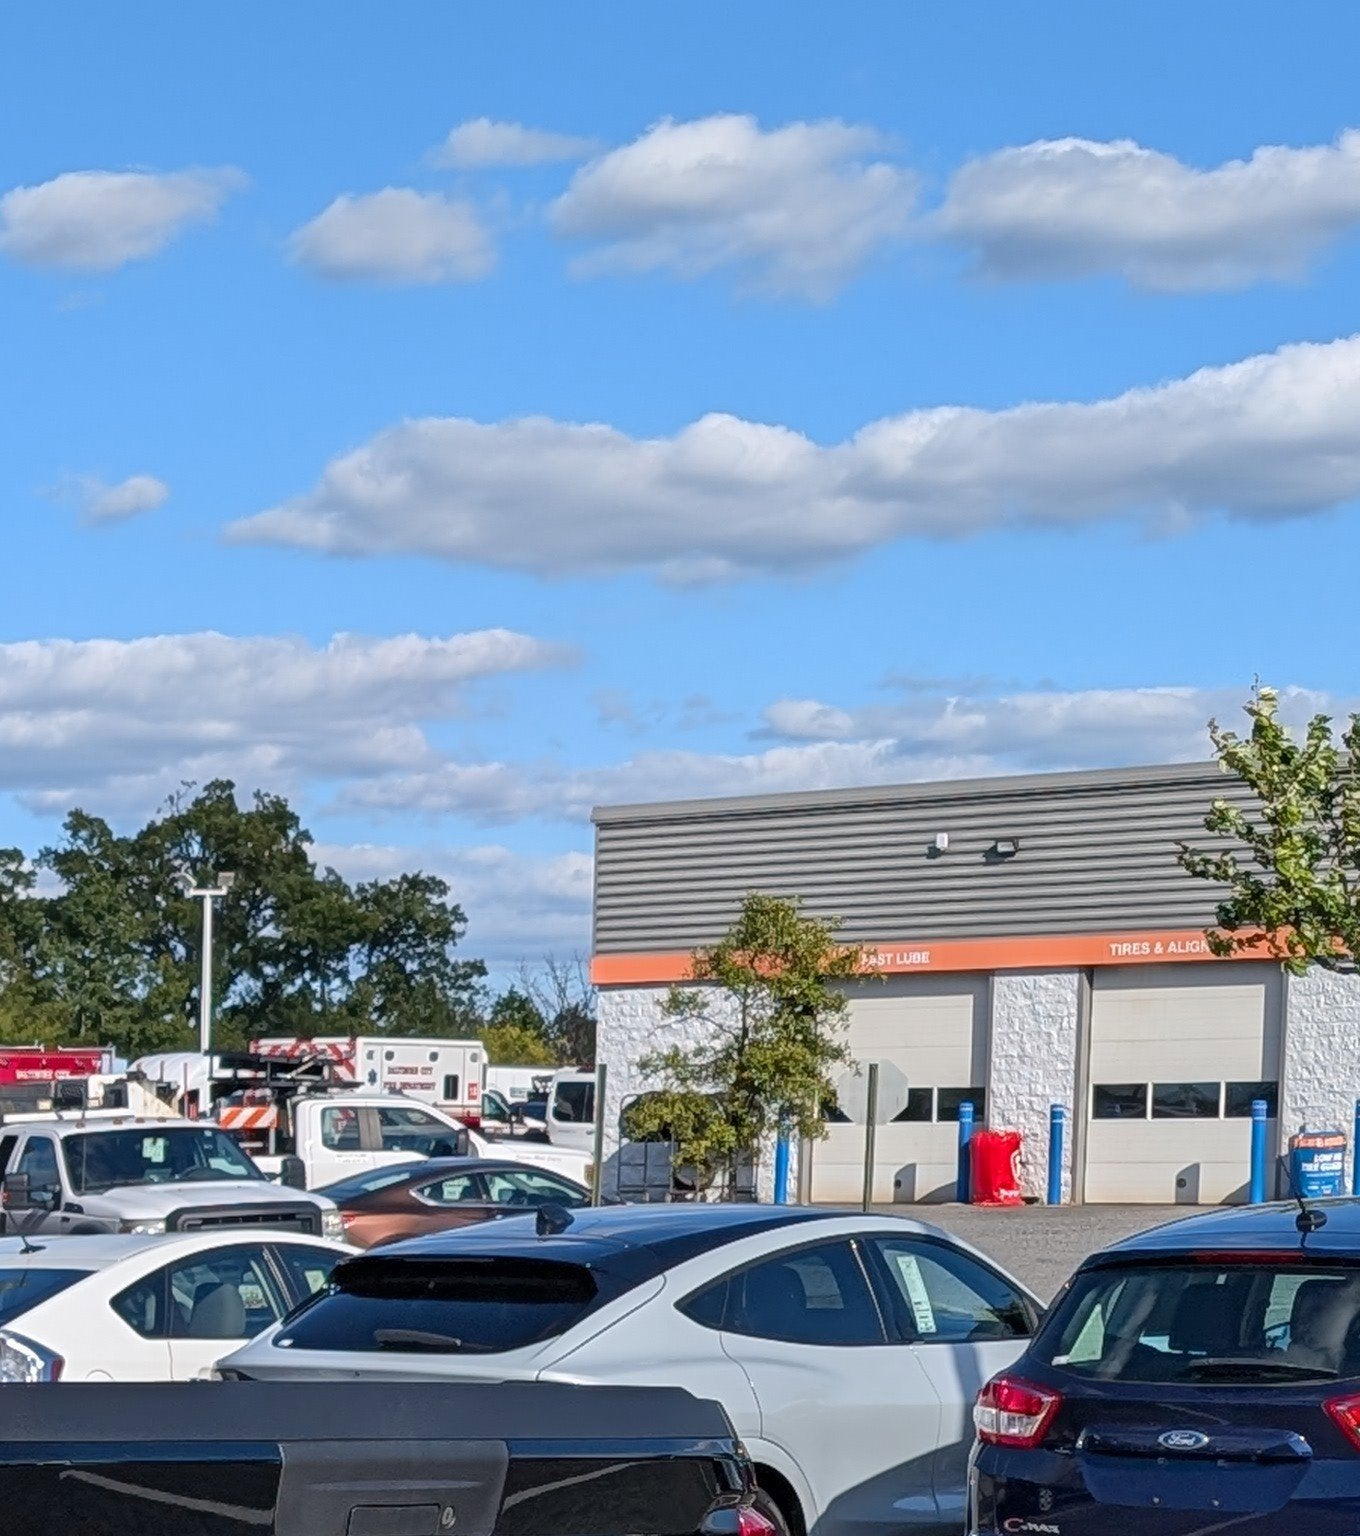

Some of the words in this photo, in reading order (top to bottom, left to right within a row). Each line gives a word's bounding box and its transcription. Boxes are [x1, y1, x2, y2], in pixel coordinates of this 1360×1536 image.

[1109, 942, 1150, 956] TIRES
[1153, 941, 1164, 954] &
[1167, 939, 1210, 953] ALIGN
[896, 951, 930, 965] LUBE
